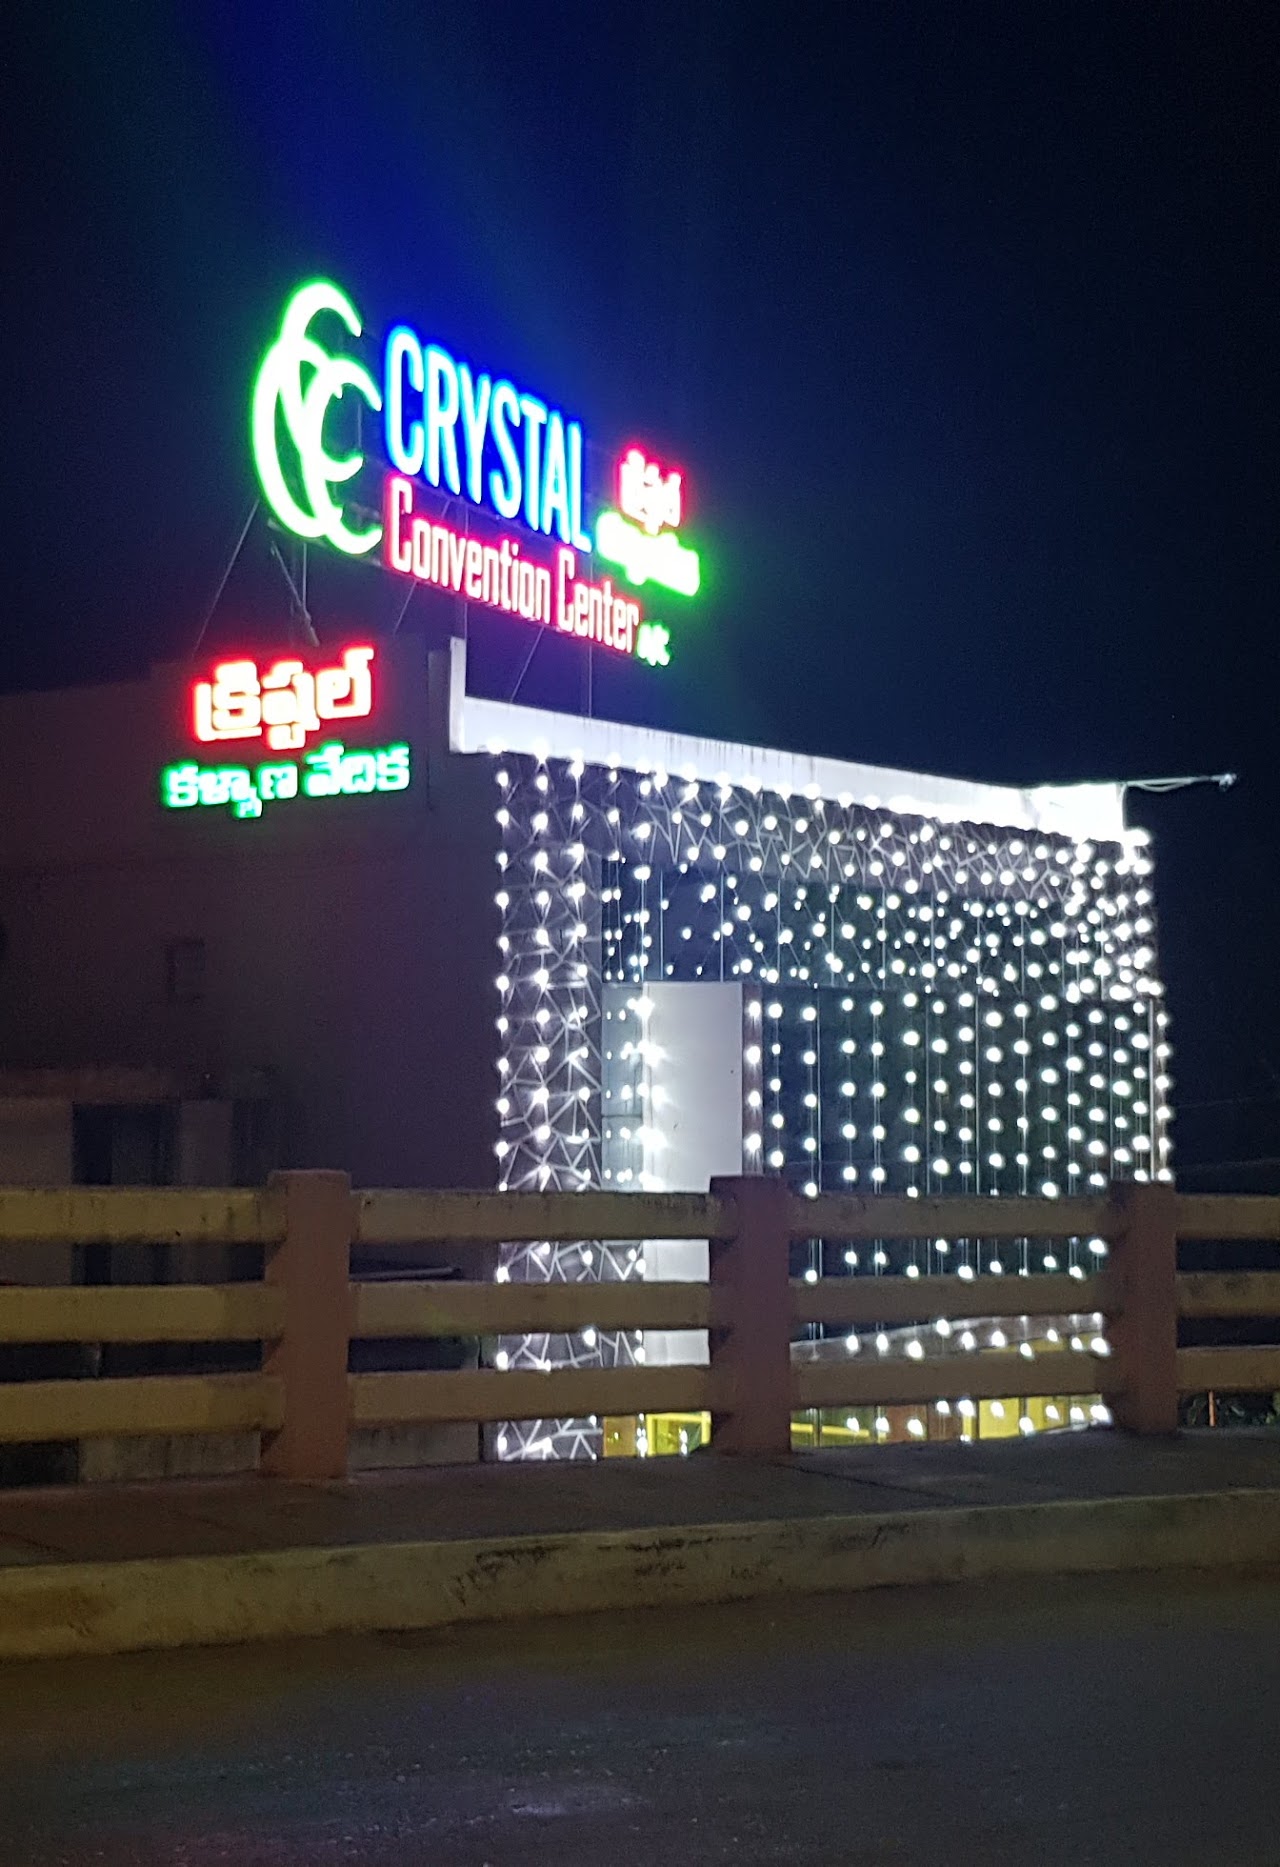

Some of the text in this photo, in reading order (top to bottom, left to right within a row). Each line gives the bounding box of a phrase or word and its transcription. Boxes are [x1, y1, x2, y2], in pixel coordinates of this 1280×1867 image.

[385, 326, 593, 553] CRYSTAL
[387, 474, 552, 624] Convention
[558, 550, 640, 655] Center
[305, 745, 410, 796] వేదిక
